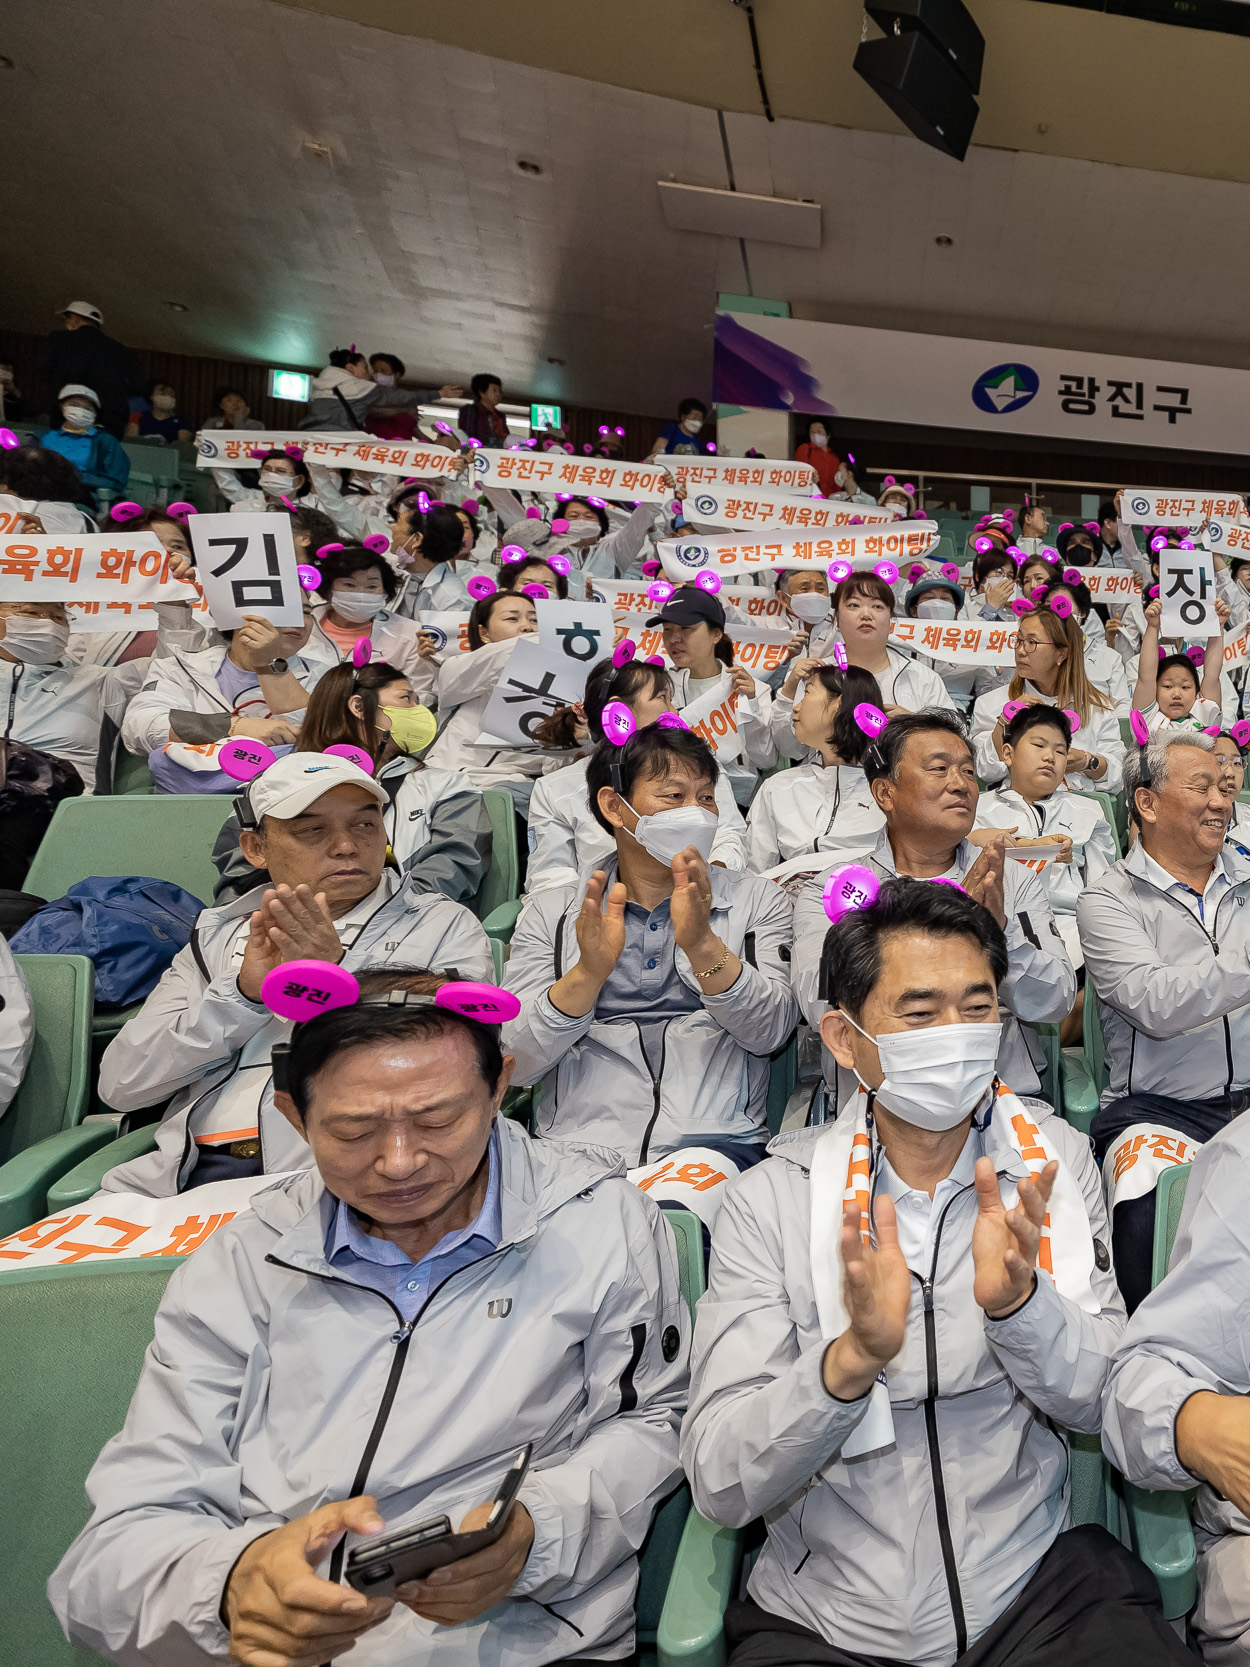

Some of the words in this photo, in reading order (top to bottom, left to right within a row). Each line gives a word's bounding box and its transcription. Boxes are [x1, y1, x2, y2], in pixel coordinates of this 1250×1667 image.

[1057, 372, 1194, 425] 광진구
[353, 444, 408, 468] 체육회
[497, 456, 553, 481] 광진구
[559, 463, 616, 487] 체육회
[674, 466, 718, 484] 광진구
[721, 467, 764, 486] 체육회
[768, 468, 814, 488] 화이팅!
[724, 498, 774, 522] 광진구
[778, 504, 828, 528] 체육회
[1155, 498, 1196, 518] 광진구
[1200, 499, 1240, 518] 체육회
[791, 537, 856, 560] 체육회
[864, 531, 932, 557] 화이팅!
[208, 534, 285, 608] 김
[1165, 566, 1213, 626] 장
[921, 625, 982, 653] 체육회
[233, 747, 263, 766] 광진
[409, 808, 425, 817] NIKE
[842, 880, 868, 906] 광진
[281, 980, 332, 1006] 광진
[459, 1001, 500, 1015] 광진
